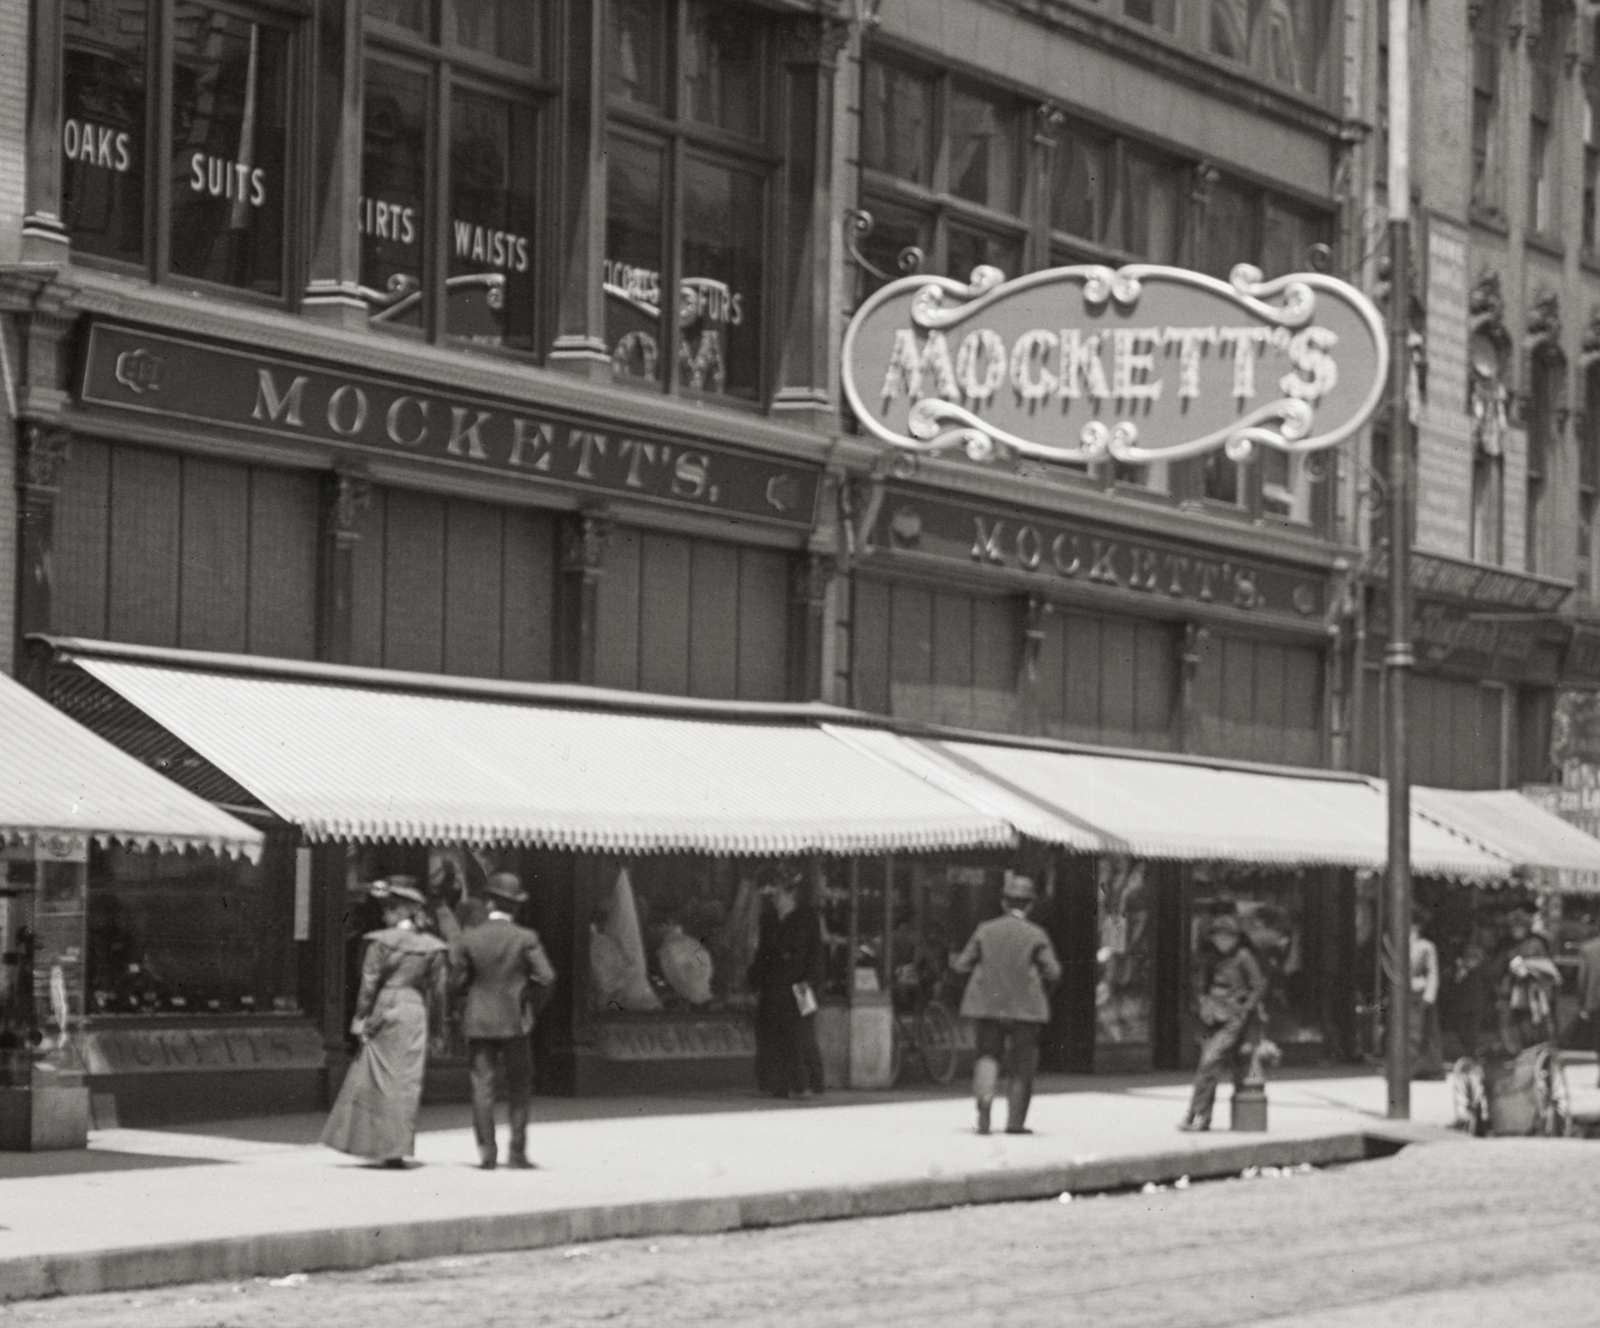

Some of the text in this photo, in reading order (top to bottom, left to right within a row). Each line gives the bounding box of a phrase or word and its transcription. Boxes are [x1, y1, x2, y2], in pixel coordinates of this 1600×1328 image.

[64, 119, 130, 172] OAKS
[190, 153, 266, 207] SUITS
[357, 196, 415, 245] IRTS
[454, 219, 529, 272] WAISTS
[697, 282, 743, 326] FURS
[880, 325, 1338, 401] MOCKETT'S
[251, 368, 719, 503] MOCKETT'S.
